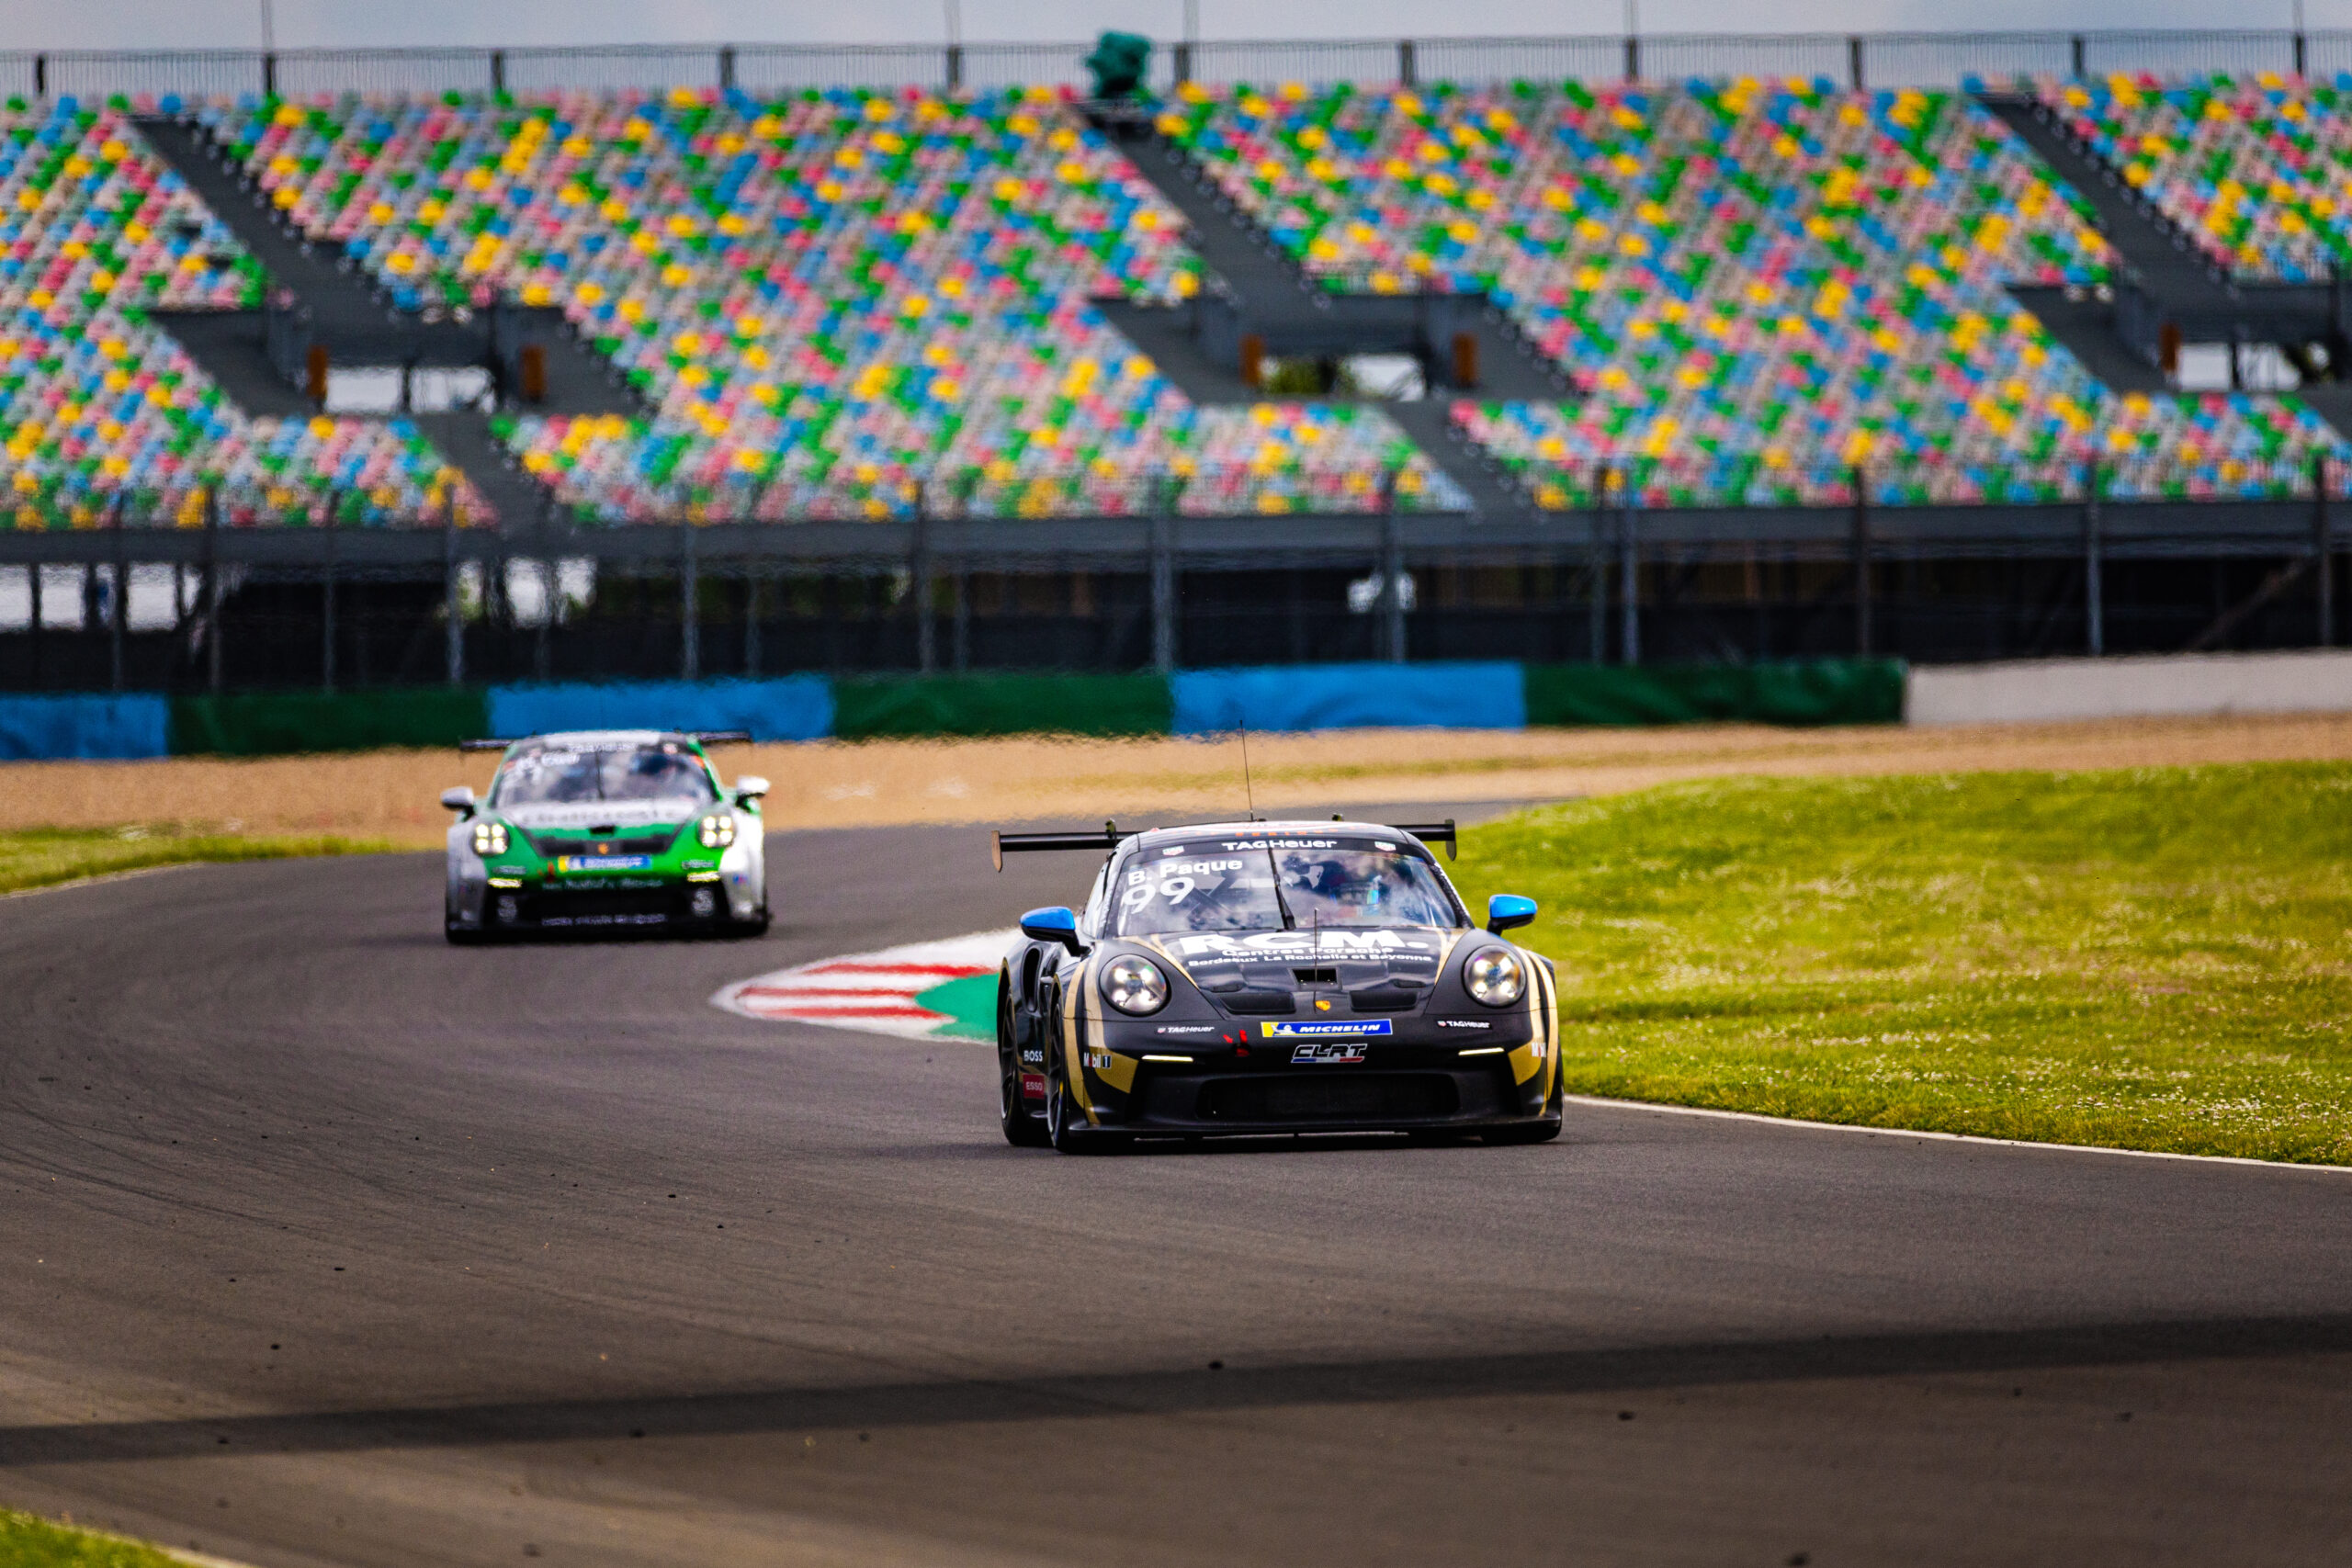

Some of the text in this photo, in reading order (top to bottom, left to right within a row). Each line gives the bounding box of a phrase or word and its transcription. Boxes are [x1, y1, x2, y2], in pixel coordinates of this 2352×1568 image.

[1127, 859, 1243, 886] B. Paque
[1120, 876, 1195, 914] 99
[1188, 957, 1259, 966] Bordeaux
[1299, 1024, 1380, 1033] MICHELIN
[1023, 1050, 1043, 1062] BOSS
